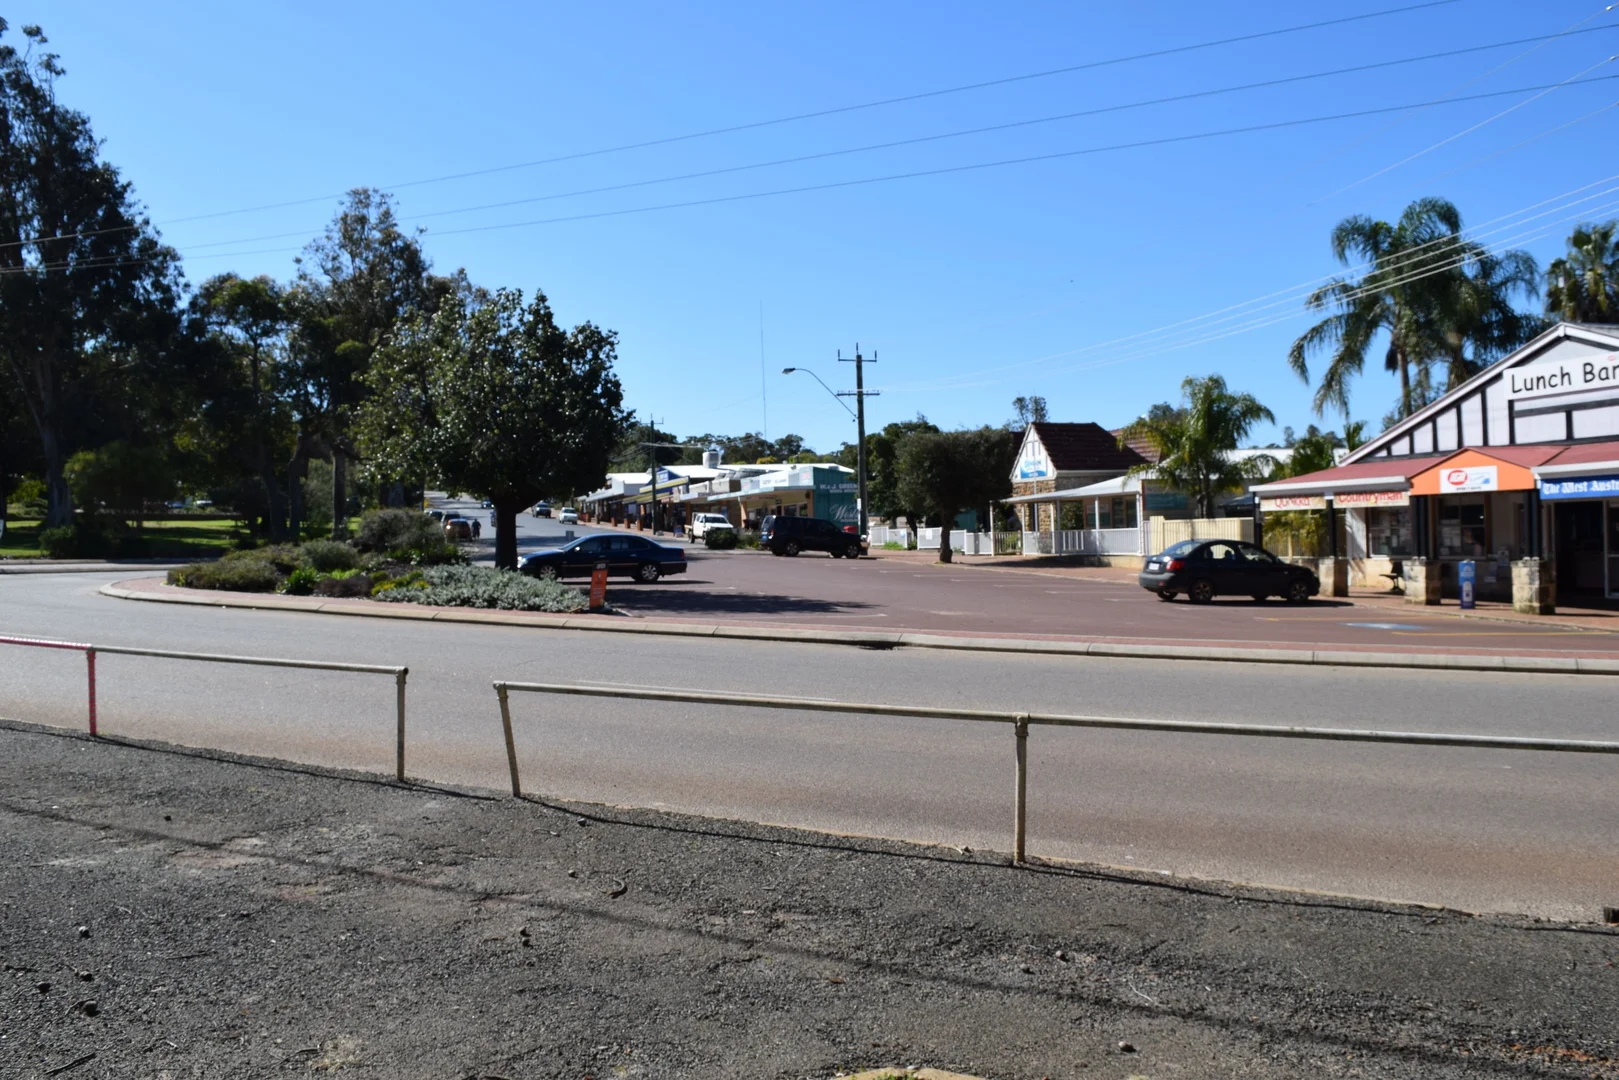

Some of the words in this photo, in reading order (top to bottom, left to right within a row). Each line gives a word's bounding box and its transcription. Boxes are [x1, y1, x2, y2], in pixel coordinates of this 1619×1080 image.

[1511, 366, 1572, 394] Lunch
[1583, 362, 1619, 384] Bar
[1543, 482, 1560, 495] The
[1561, 480, 1588, 494] West
